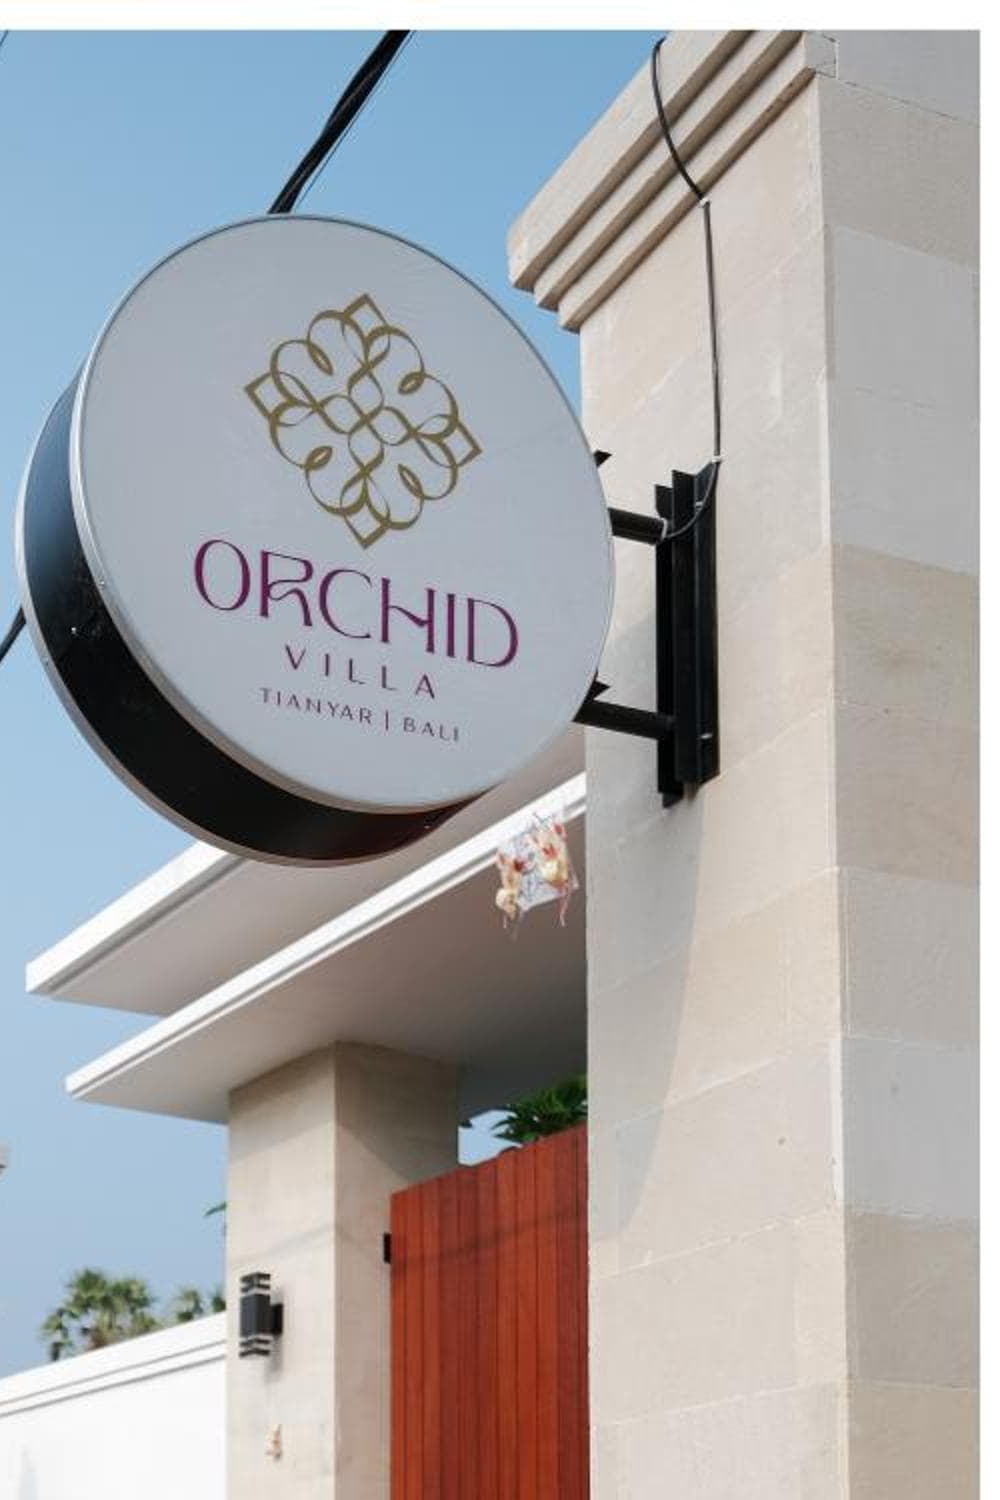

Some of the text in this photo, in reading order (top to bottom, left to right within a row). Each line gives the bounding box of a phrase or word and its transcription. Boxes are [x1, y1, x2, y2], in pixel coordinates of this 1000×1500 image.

[194, 539, 519, 667] ORCHID
[285, 645, 436, 699] VILLA
[259, 687, 374, 725] TIANYAR
[402, 716, 460, 742] BALI
